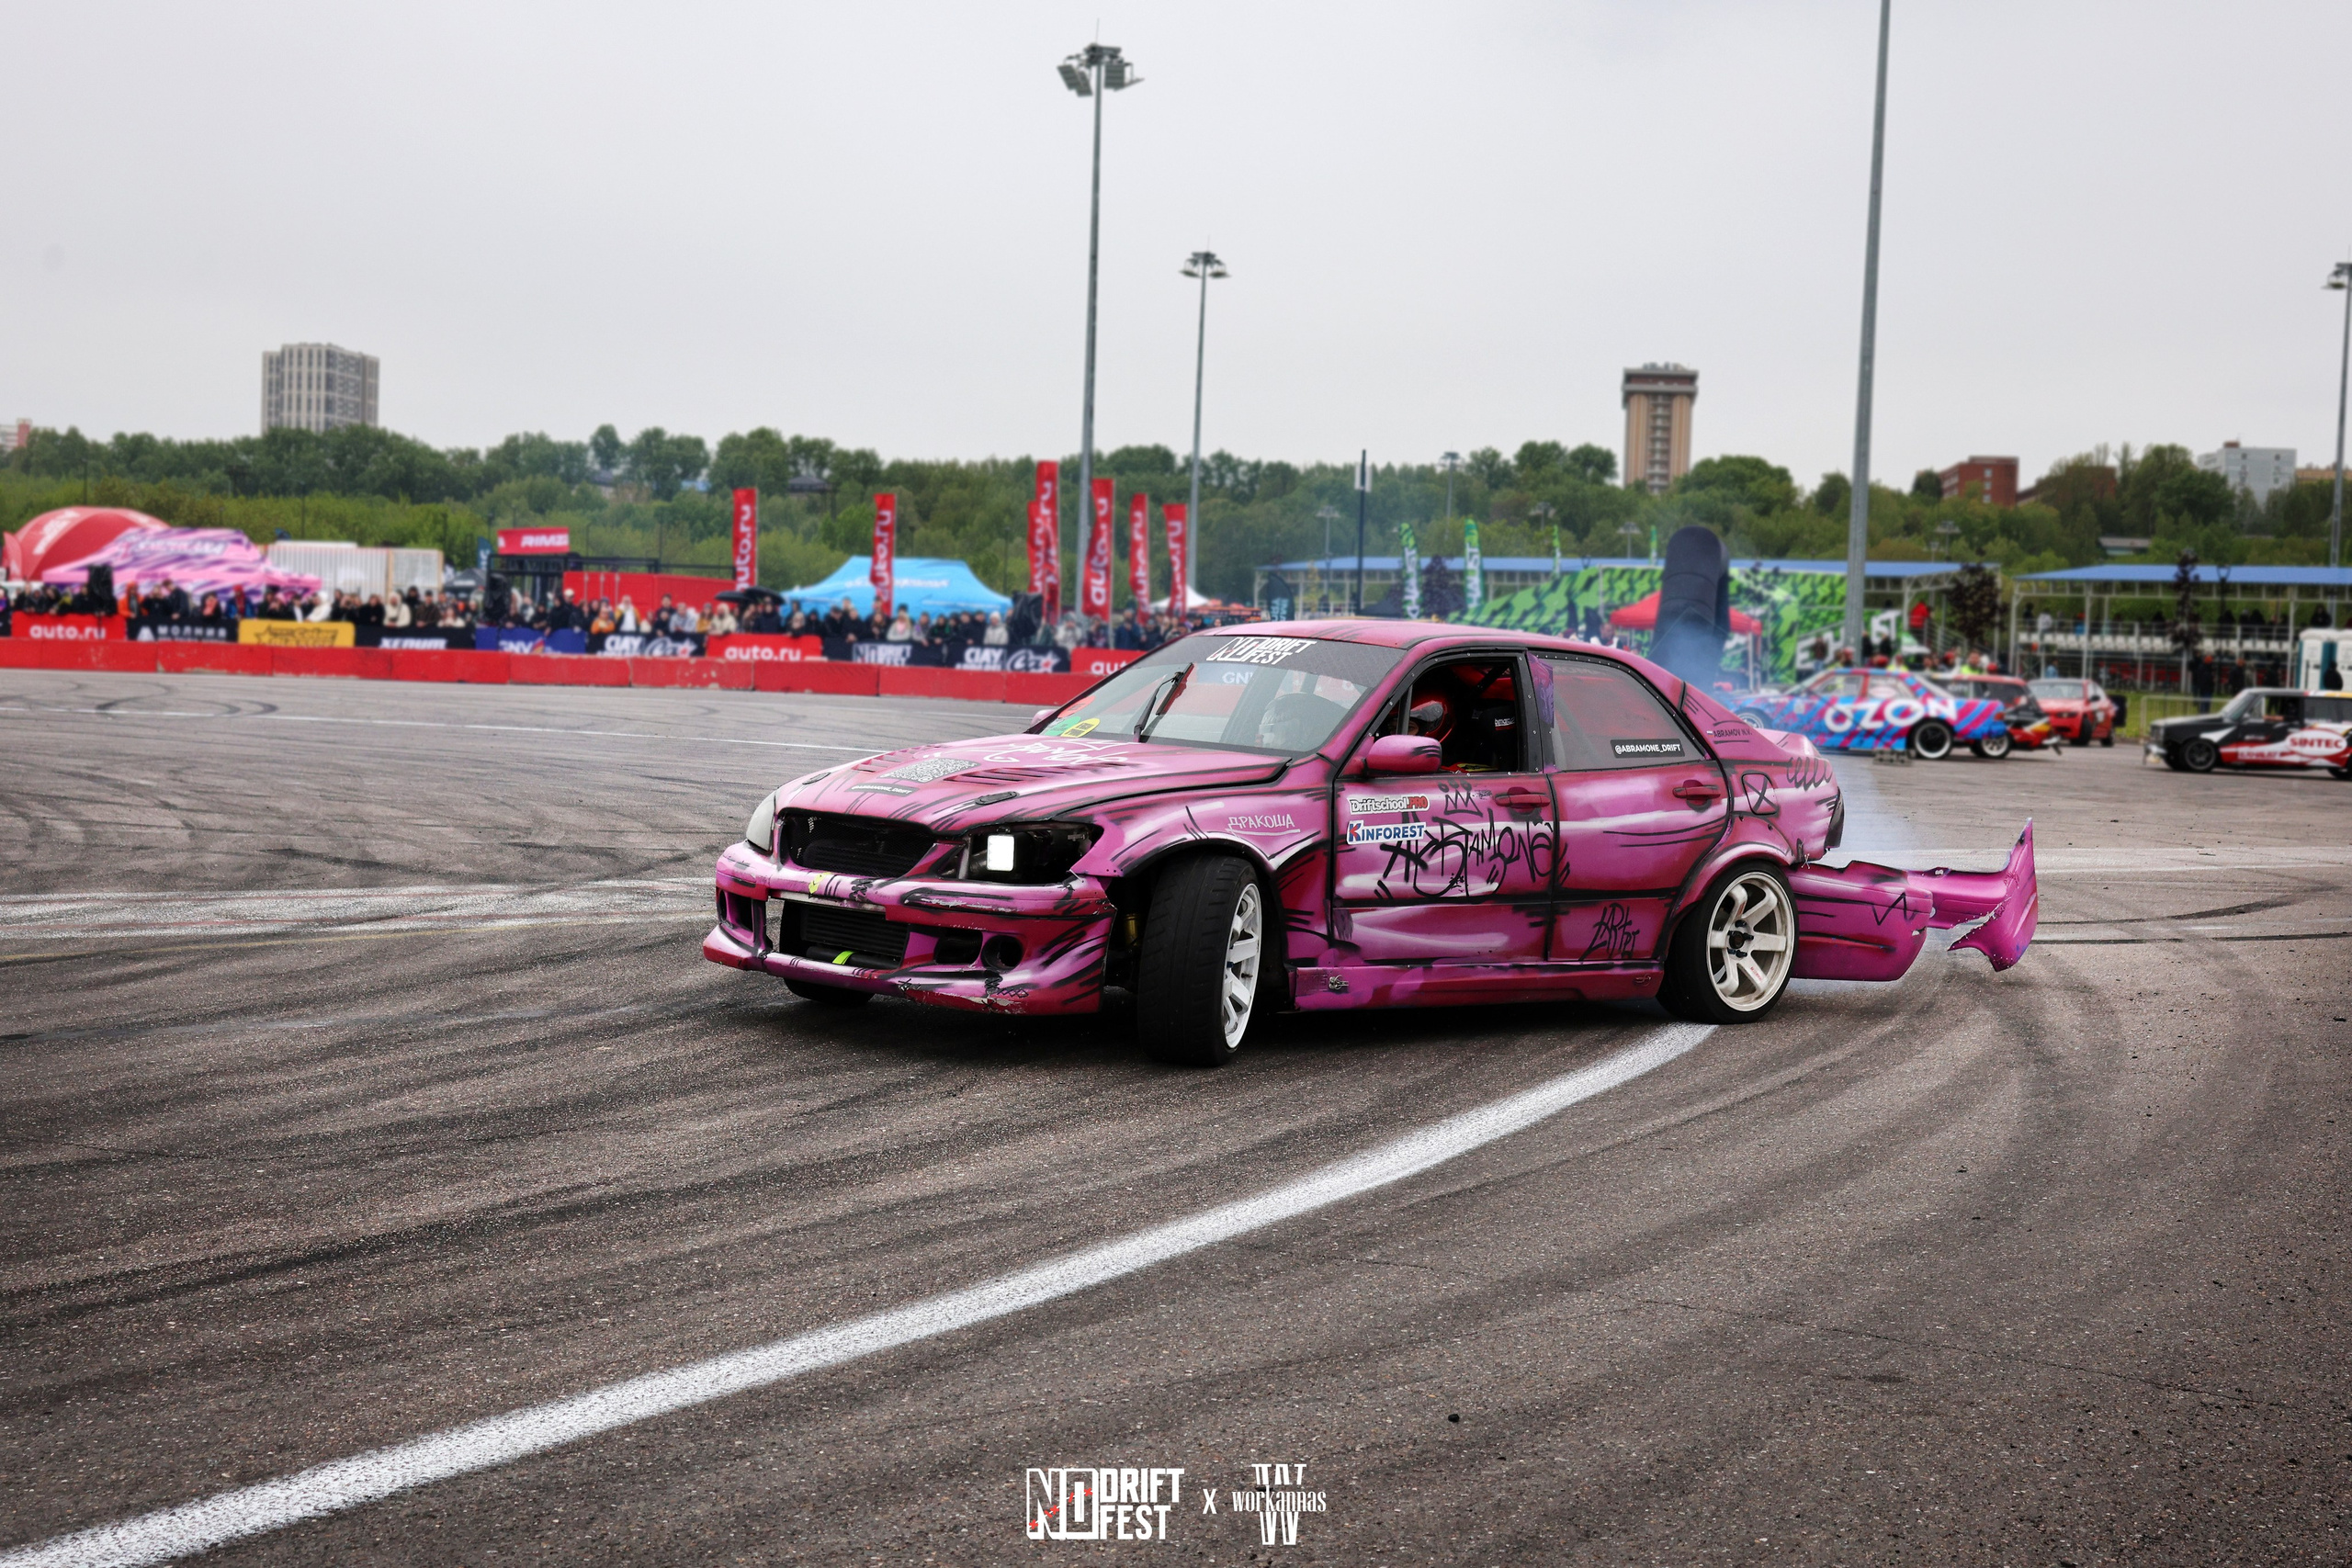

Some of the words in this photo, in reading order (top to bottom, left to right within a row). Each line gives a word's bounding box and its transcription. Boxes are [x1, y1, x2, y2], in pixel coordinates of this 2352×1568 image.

[28, 623, 107, 641] auto.ru
[724, 645, 802, 660] auto.ru
[1261, 637, 1317, 654] DRIFT
[1247, 650, 1294, 665] FEST
[1825, 697, 1957, 733] OZON
[1614, 743, 1681, 755] @ABRAMONE_DRIFT
[2289, 738, 2344, 750] SINTEC
[1227, 813, 1296, 830] ДРАКОША
[1349, 823, 1425, 842] KINFOREST
